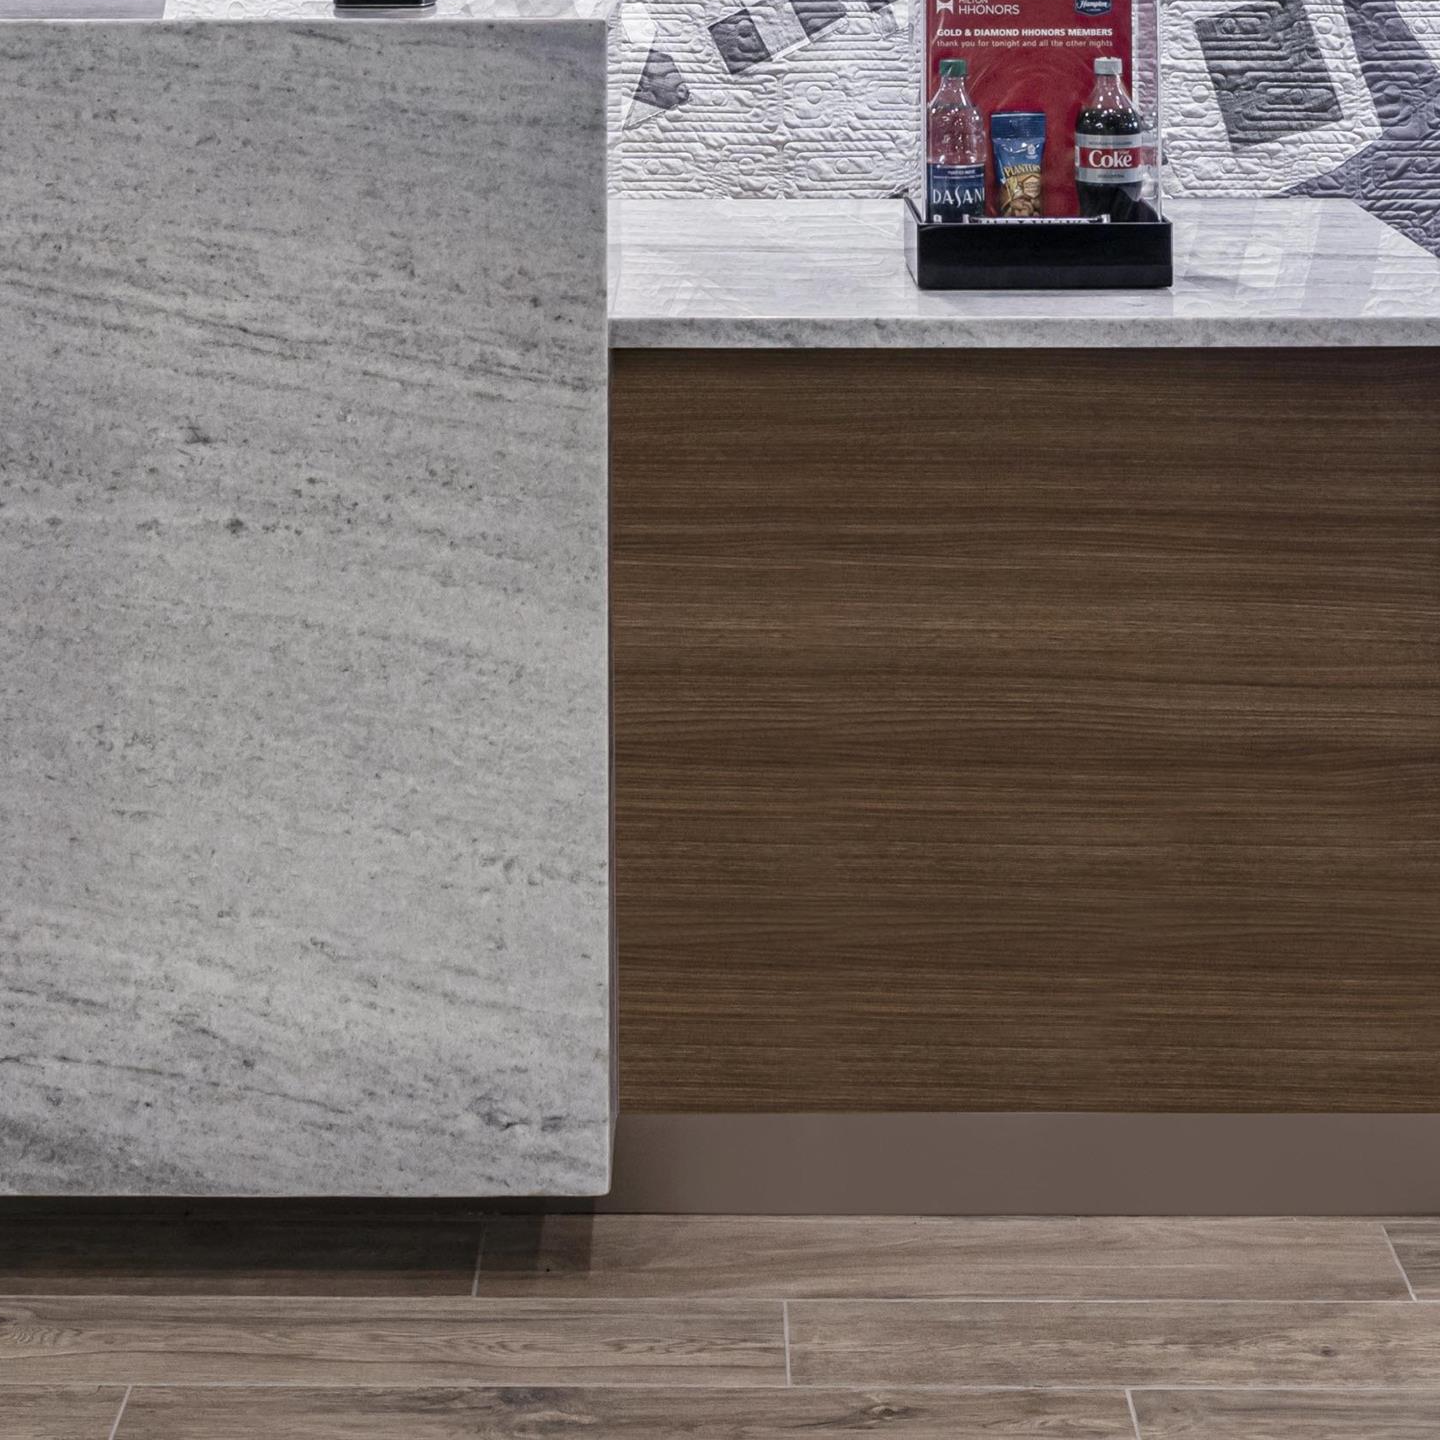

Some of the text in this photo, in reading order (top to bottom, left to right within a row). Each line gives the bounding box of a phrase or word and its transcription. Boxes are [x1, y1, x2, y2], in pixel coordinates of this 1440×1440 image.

[958, 4, 1020, 15] HHONORS
[936, 28, 1113, 37] GOLD & DIAMOND HHONORS MEMBERS
[936, 39, 1113, 49] thank you for tonight and all the other nights
[1088, 149, 1133, 168] Coke
